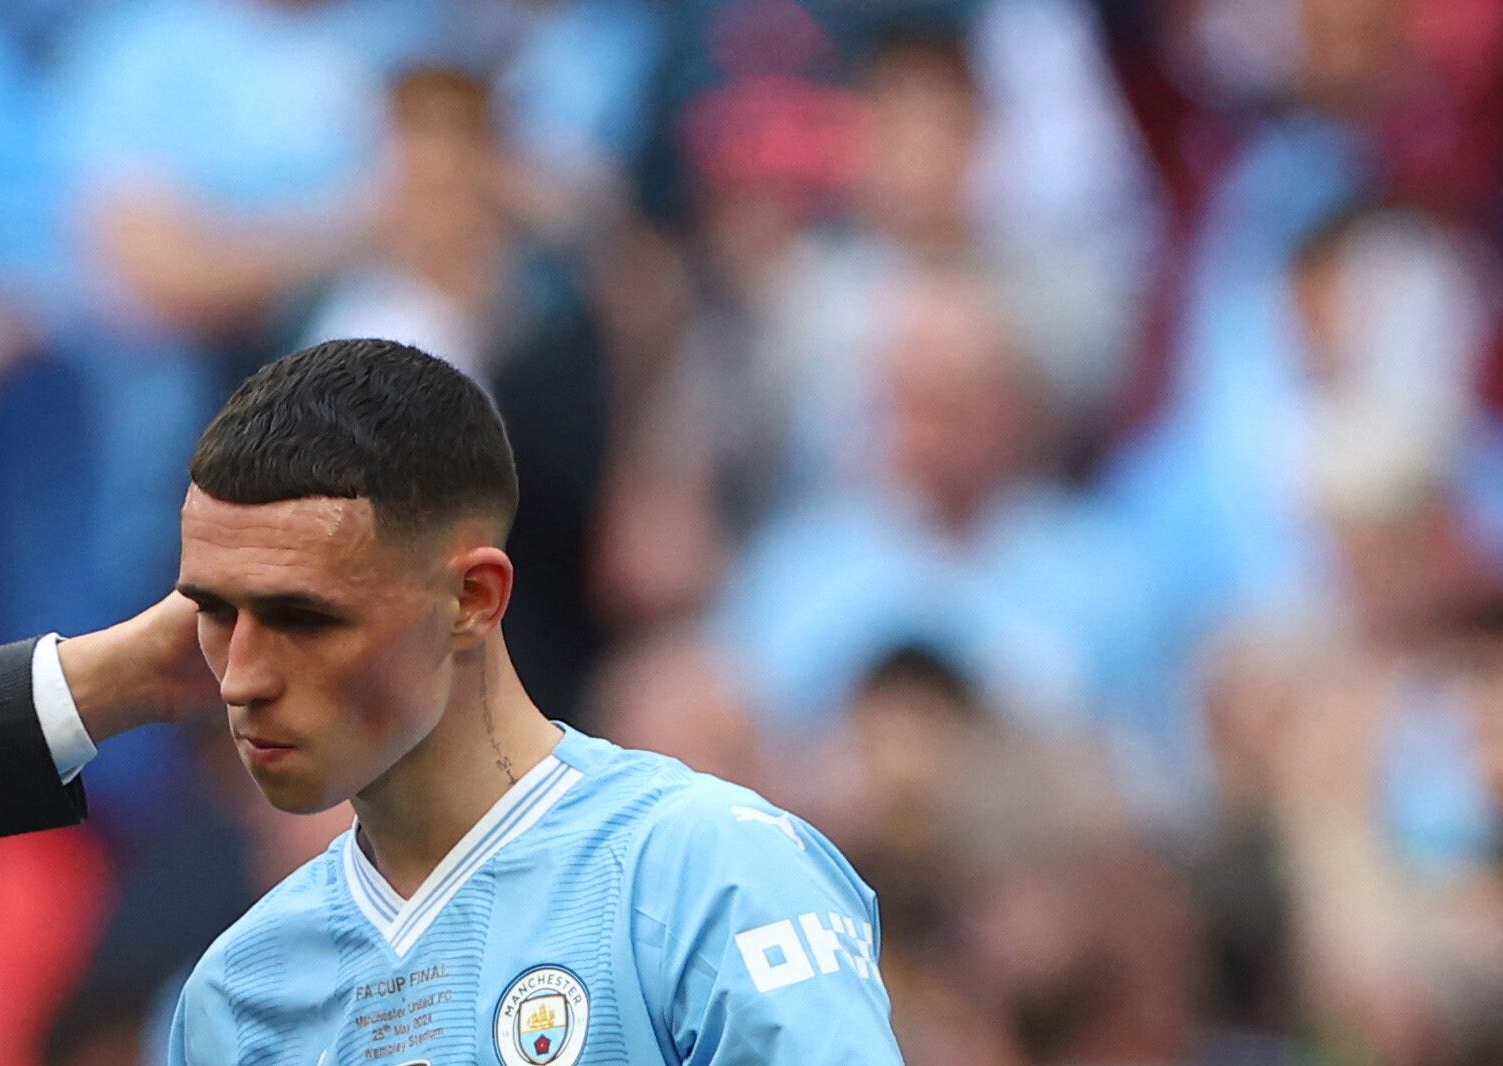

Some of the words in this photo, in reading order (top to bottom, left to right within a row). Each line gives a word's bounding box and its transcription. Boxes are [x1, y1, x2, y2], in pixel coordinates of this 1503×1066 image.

[355, 984, 373, 1001] FA
[377, 976, 406, 997] CUP
[409, 964, 449, 987] FINAL
[504, 974, 582, 1018] MANCHESTER
